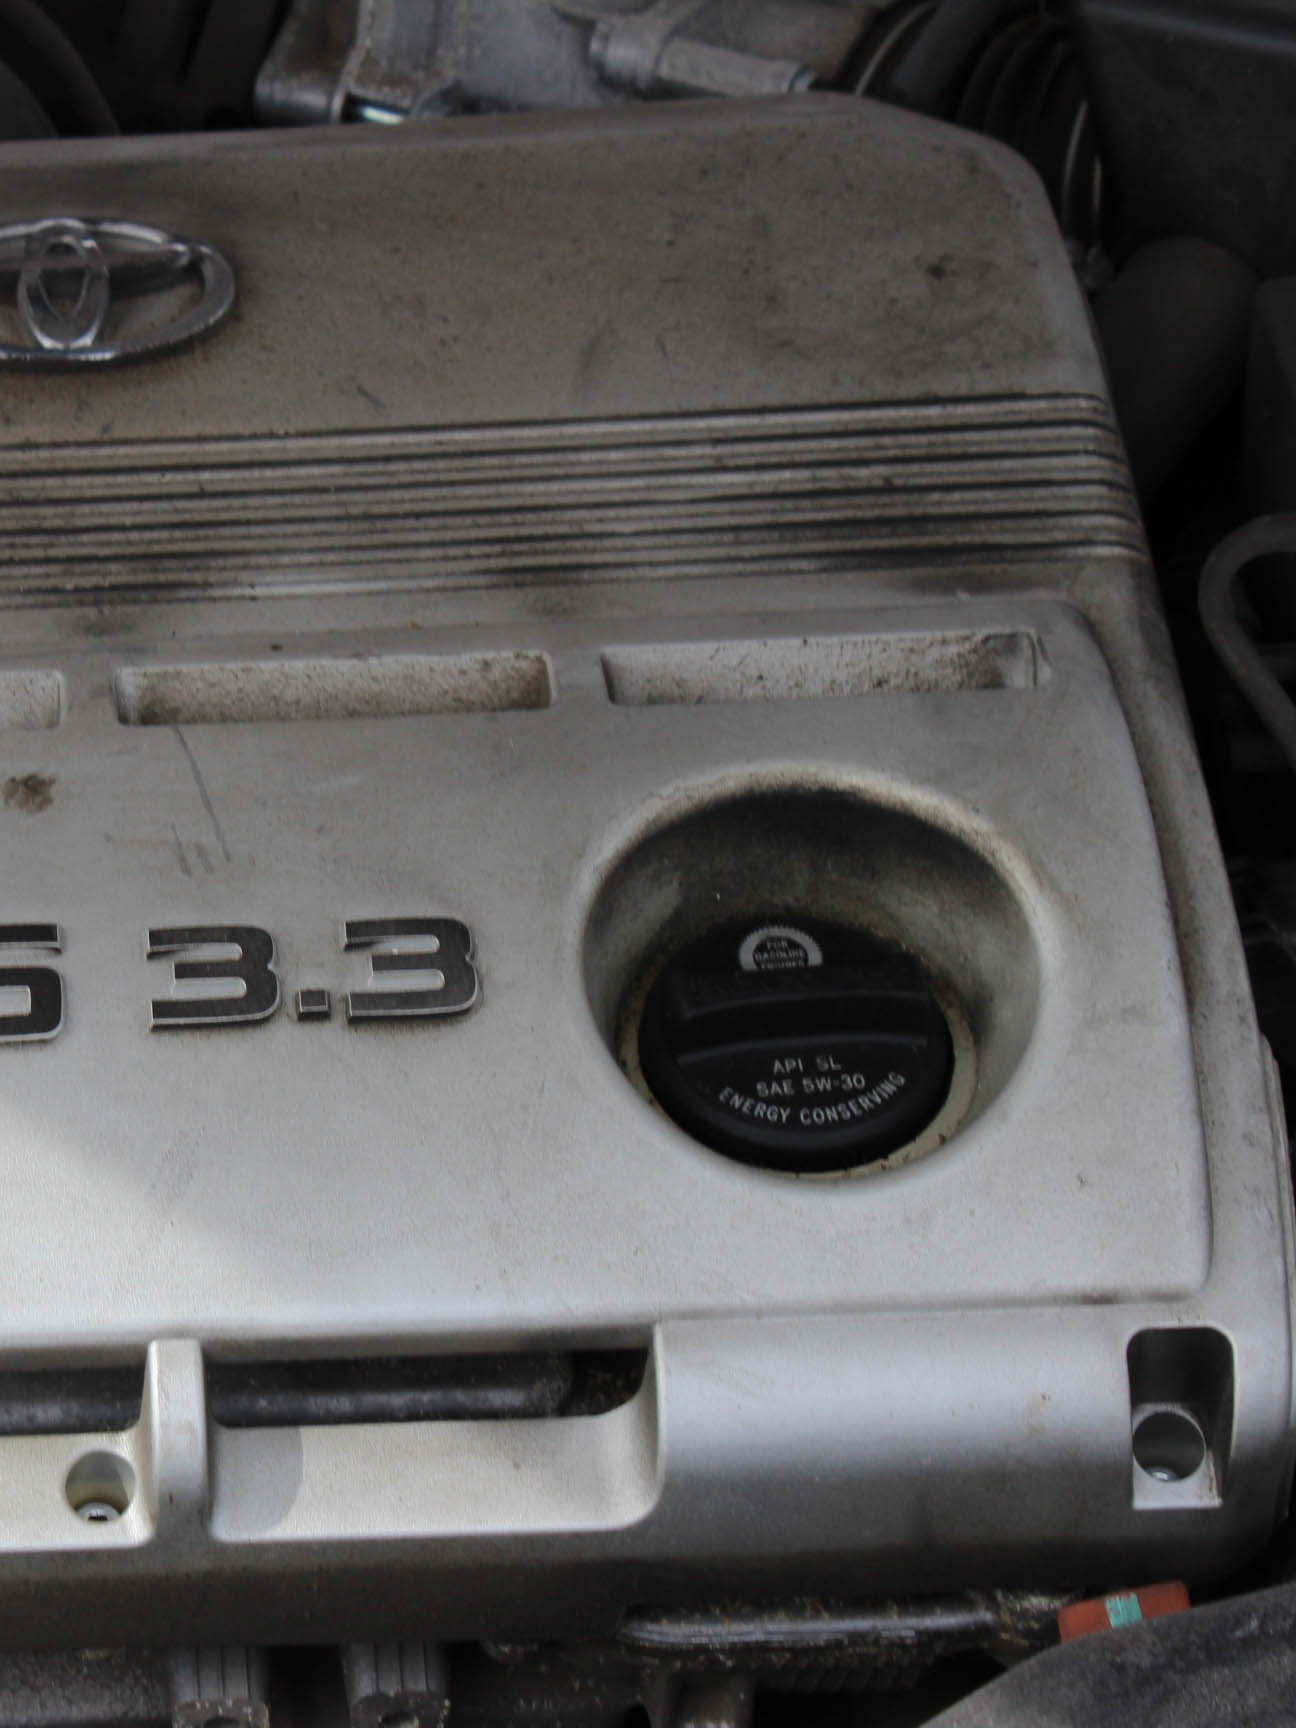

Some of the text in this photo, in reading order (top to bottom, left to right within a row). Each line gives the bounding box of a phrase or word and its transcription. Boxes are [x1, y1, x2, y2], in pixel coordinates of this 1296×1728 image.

[765, 938, 789, 950] FOR
[146, 917, 482, 1034] 3.3
[773, 1055, 842, 1075] API SL
[756, 1073, 866, 1098] SAE 5W-30
[718, 1071, 906, 1126] ENERGY CONSERVING
